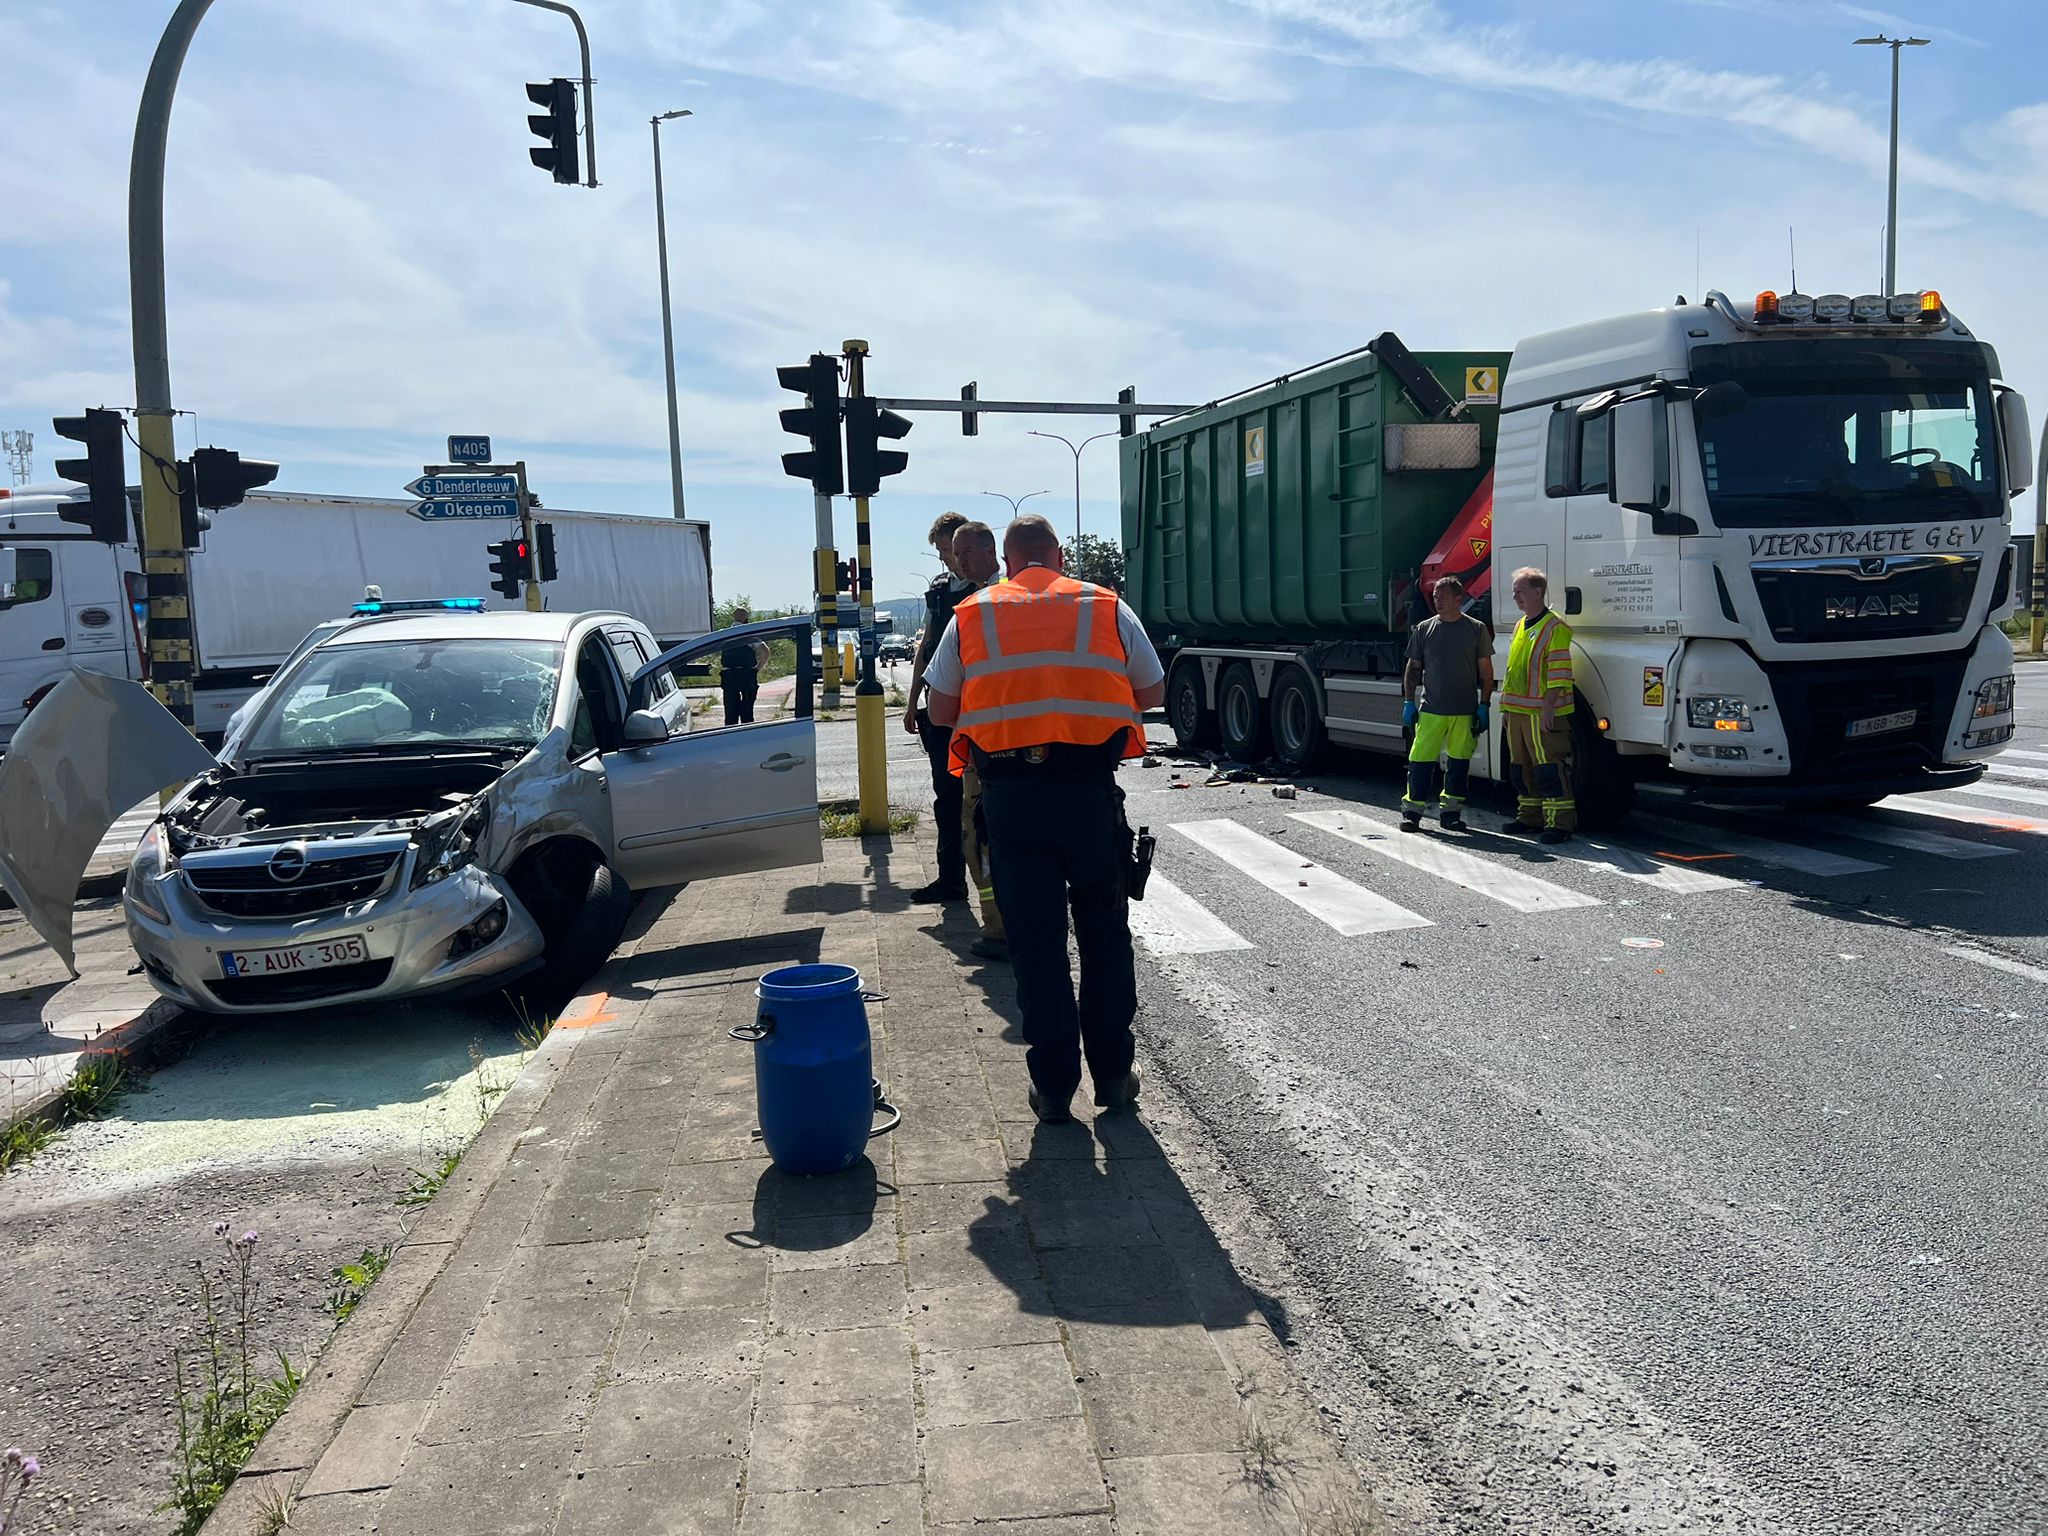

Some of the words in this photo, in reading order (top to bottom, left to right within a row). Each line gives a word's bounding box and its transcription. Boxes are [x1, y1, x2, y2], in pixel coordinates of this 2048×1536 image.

[453, 442, 487, 456] N405
[422, 481, 431, 493] 6
[435, 480, 510, 494] Denderleeuw
[424, 503, 435, 517] 2
[444, 502, 507, 518] Okegem
[1748, 528, 1916, 557] VIERSTRAETE
[1925, 526, 1941, 548] G
[1946, 525, 1965, 547] &
[1970, 524, 1985, 545] V
[1826, 593, 1919, 619] MAN
[236, 940, 361, 973] 2-AUK-305
